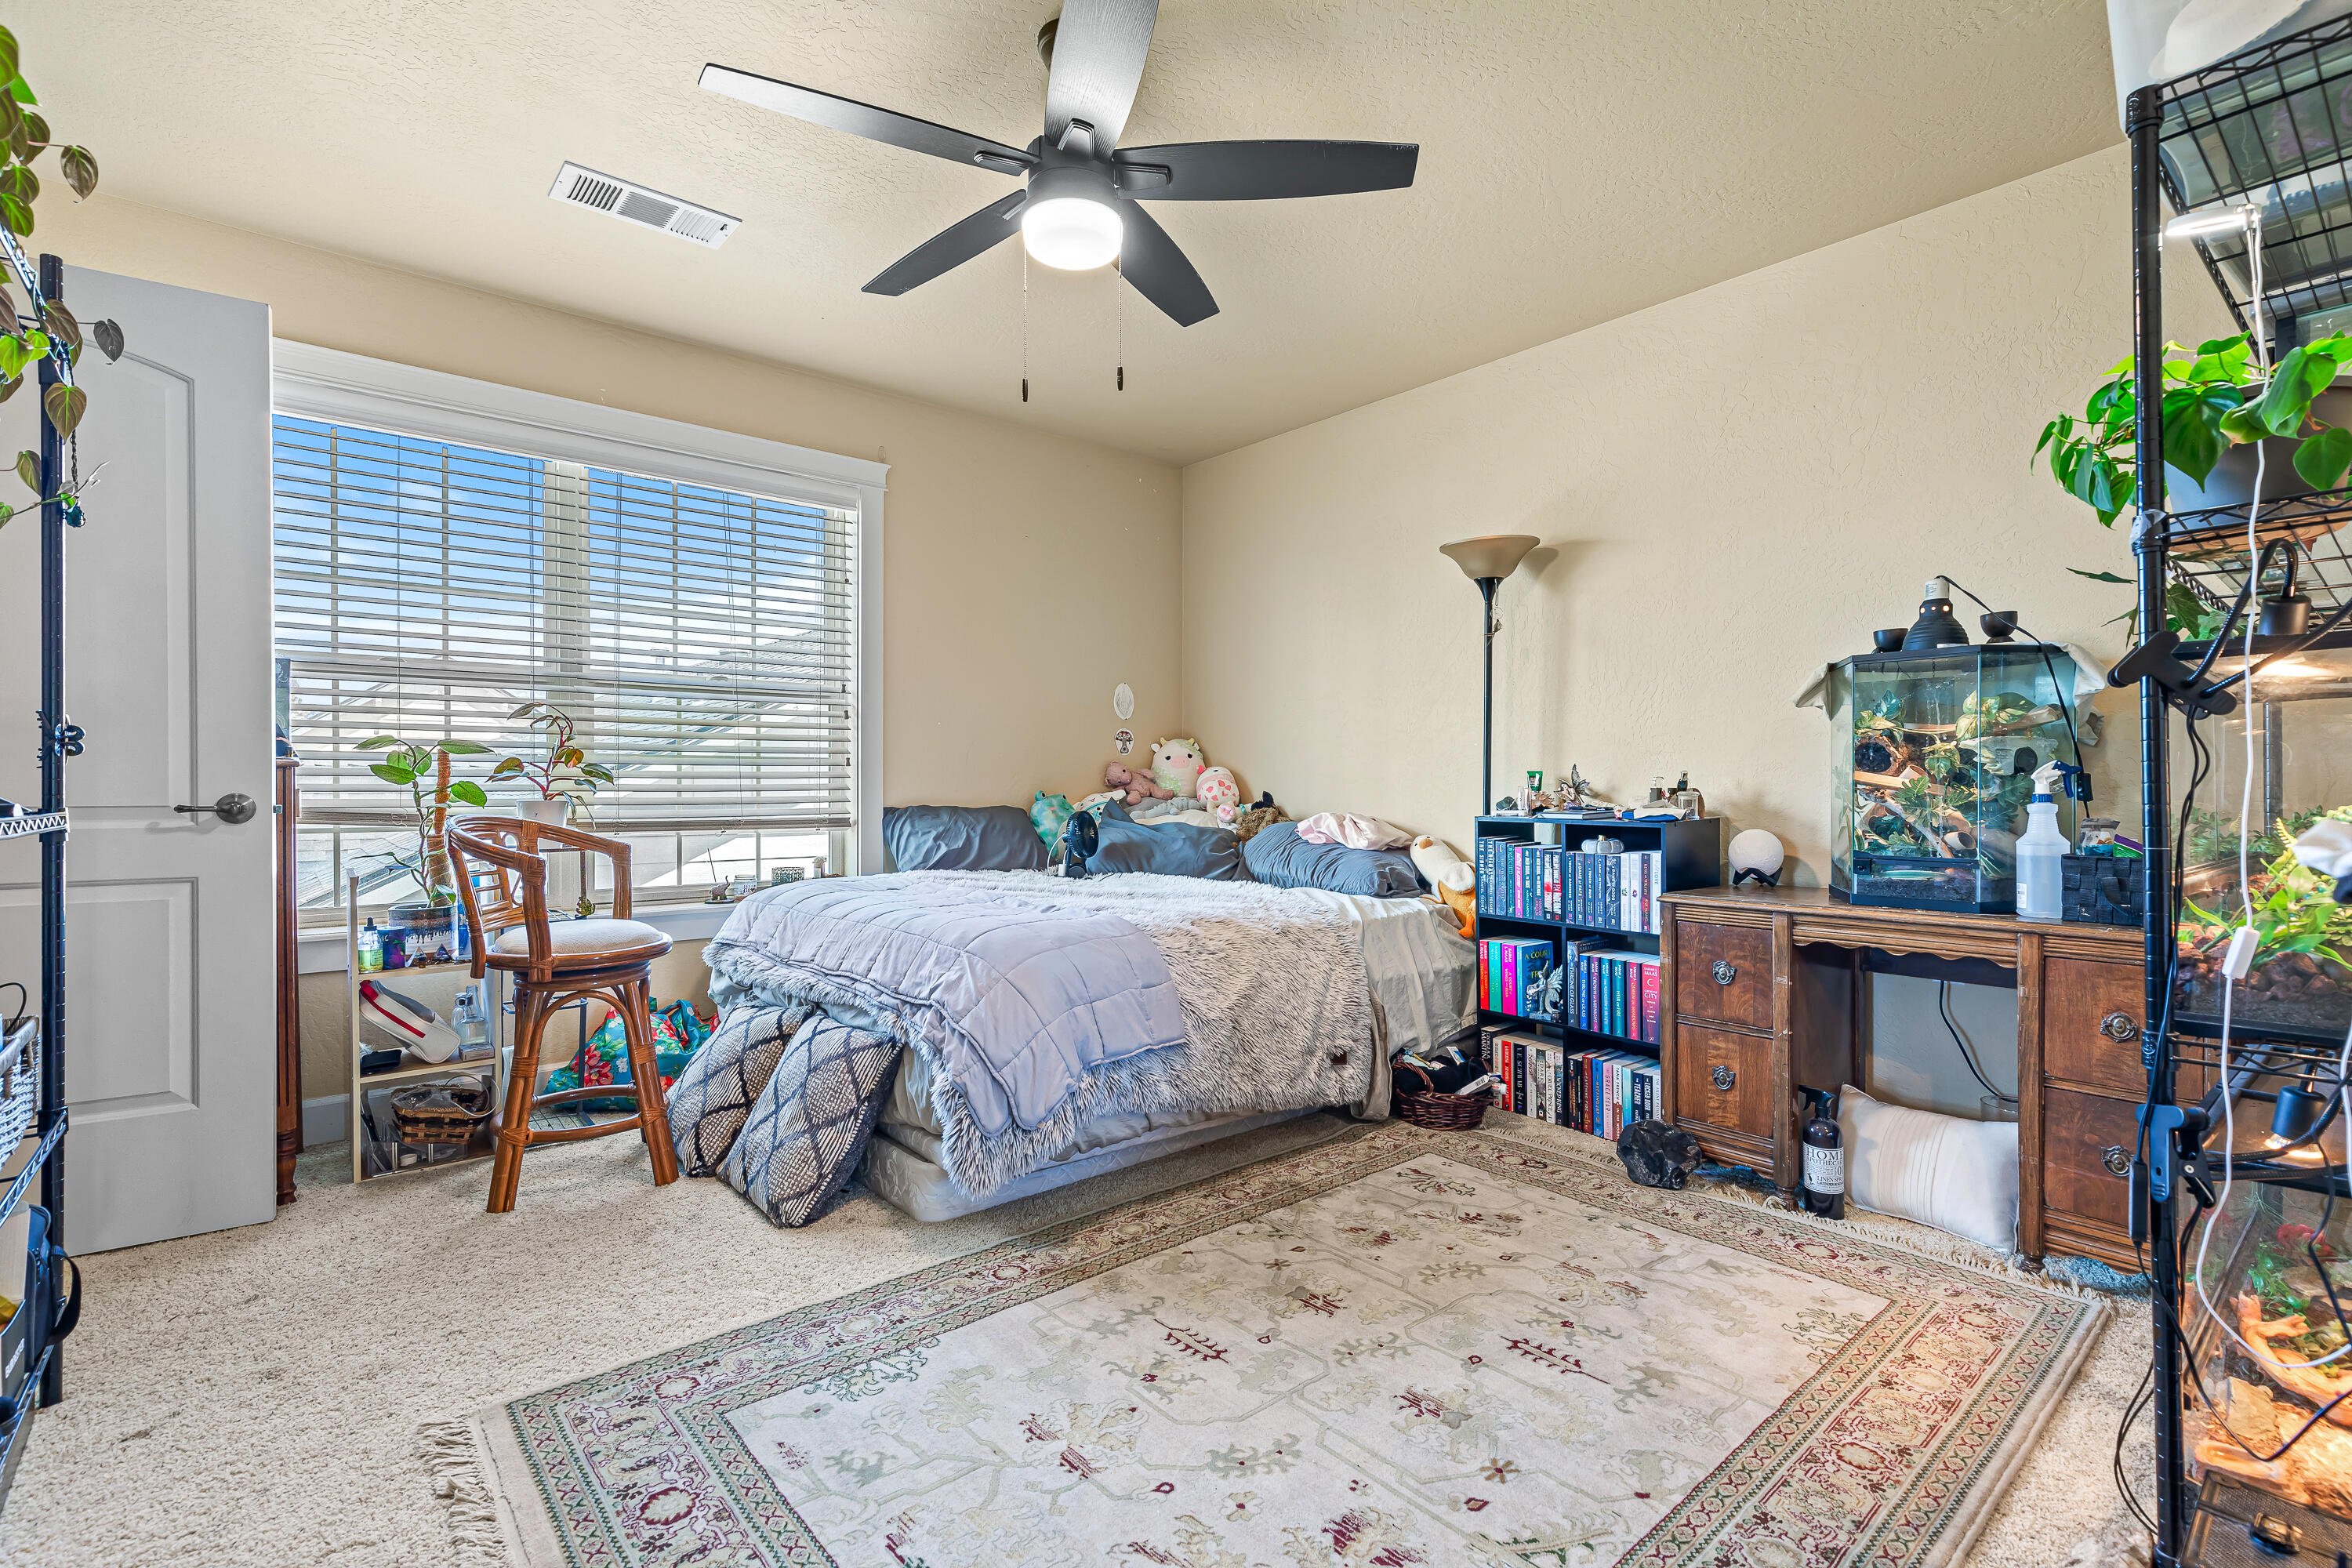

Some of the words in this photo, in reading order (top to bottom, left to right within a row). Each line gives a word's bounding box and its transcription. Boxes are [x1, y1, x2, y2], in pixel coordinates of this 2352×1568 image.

[1531, 949, 1551, 959] COURT
[1806, 1147, 1843, 1160] HOME
[1806, 1156, 1842, 1165] APOTHECAR
